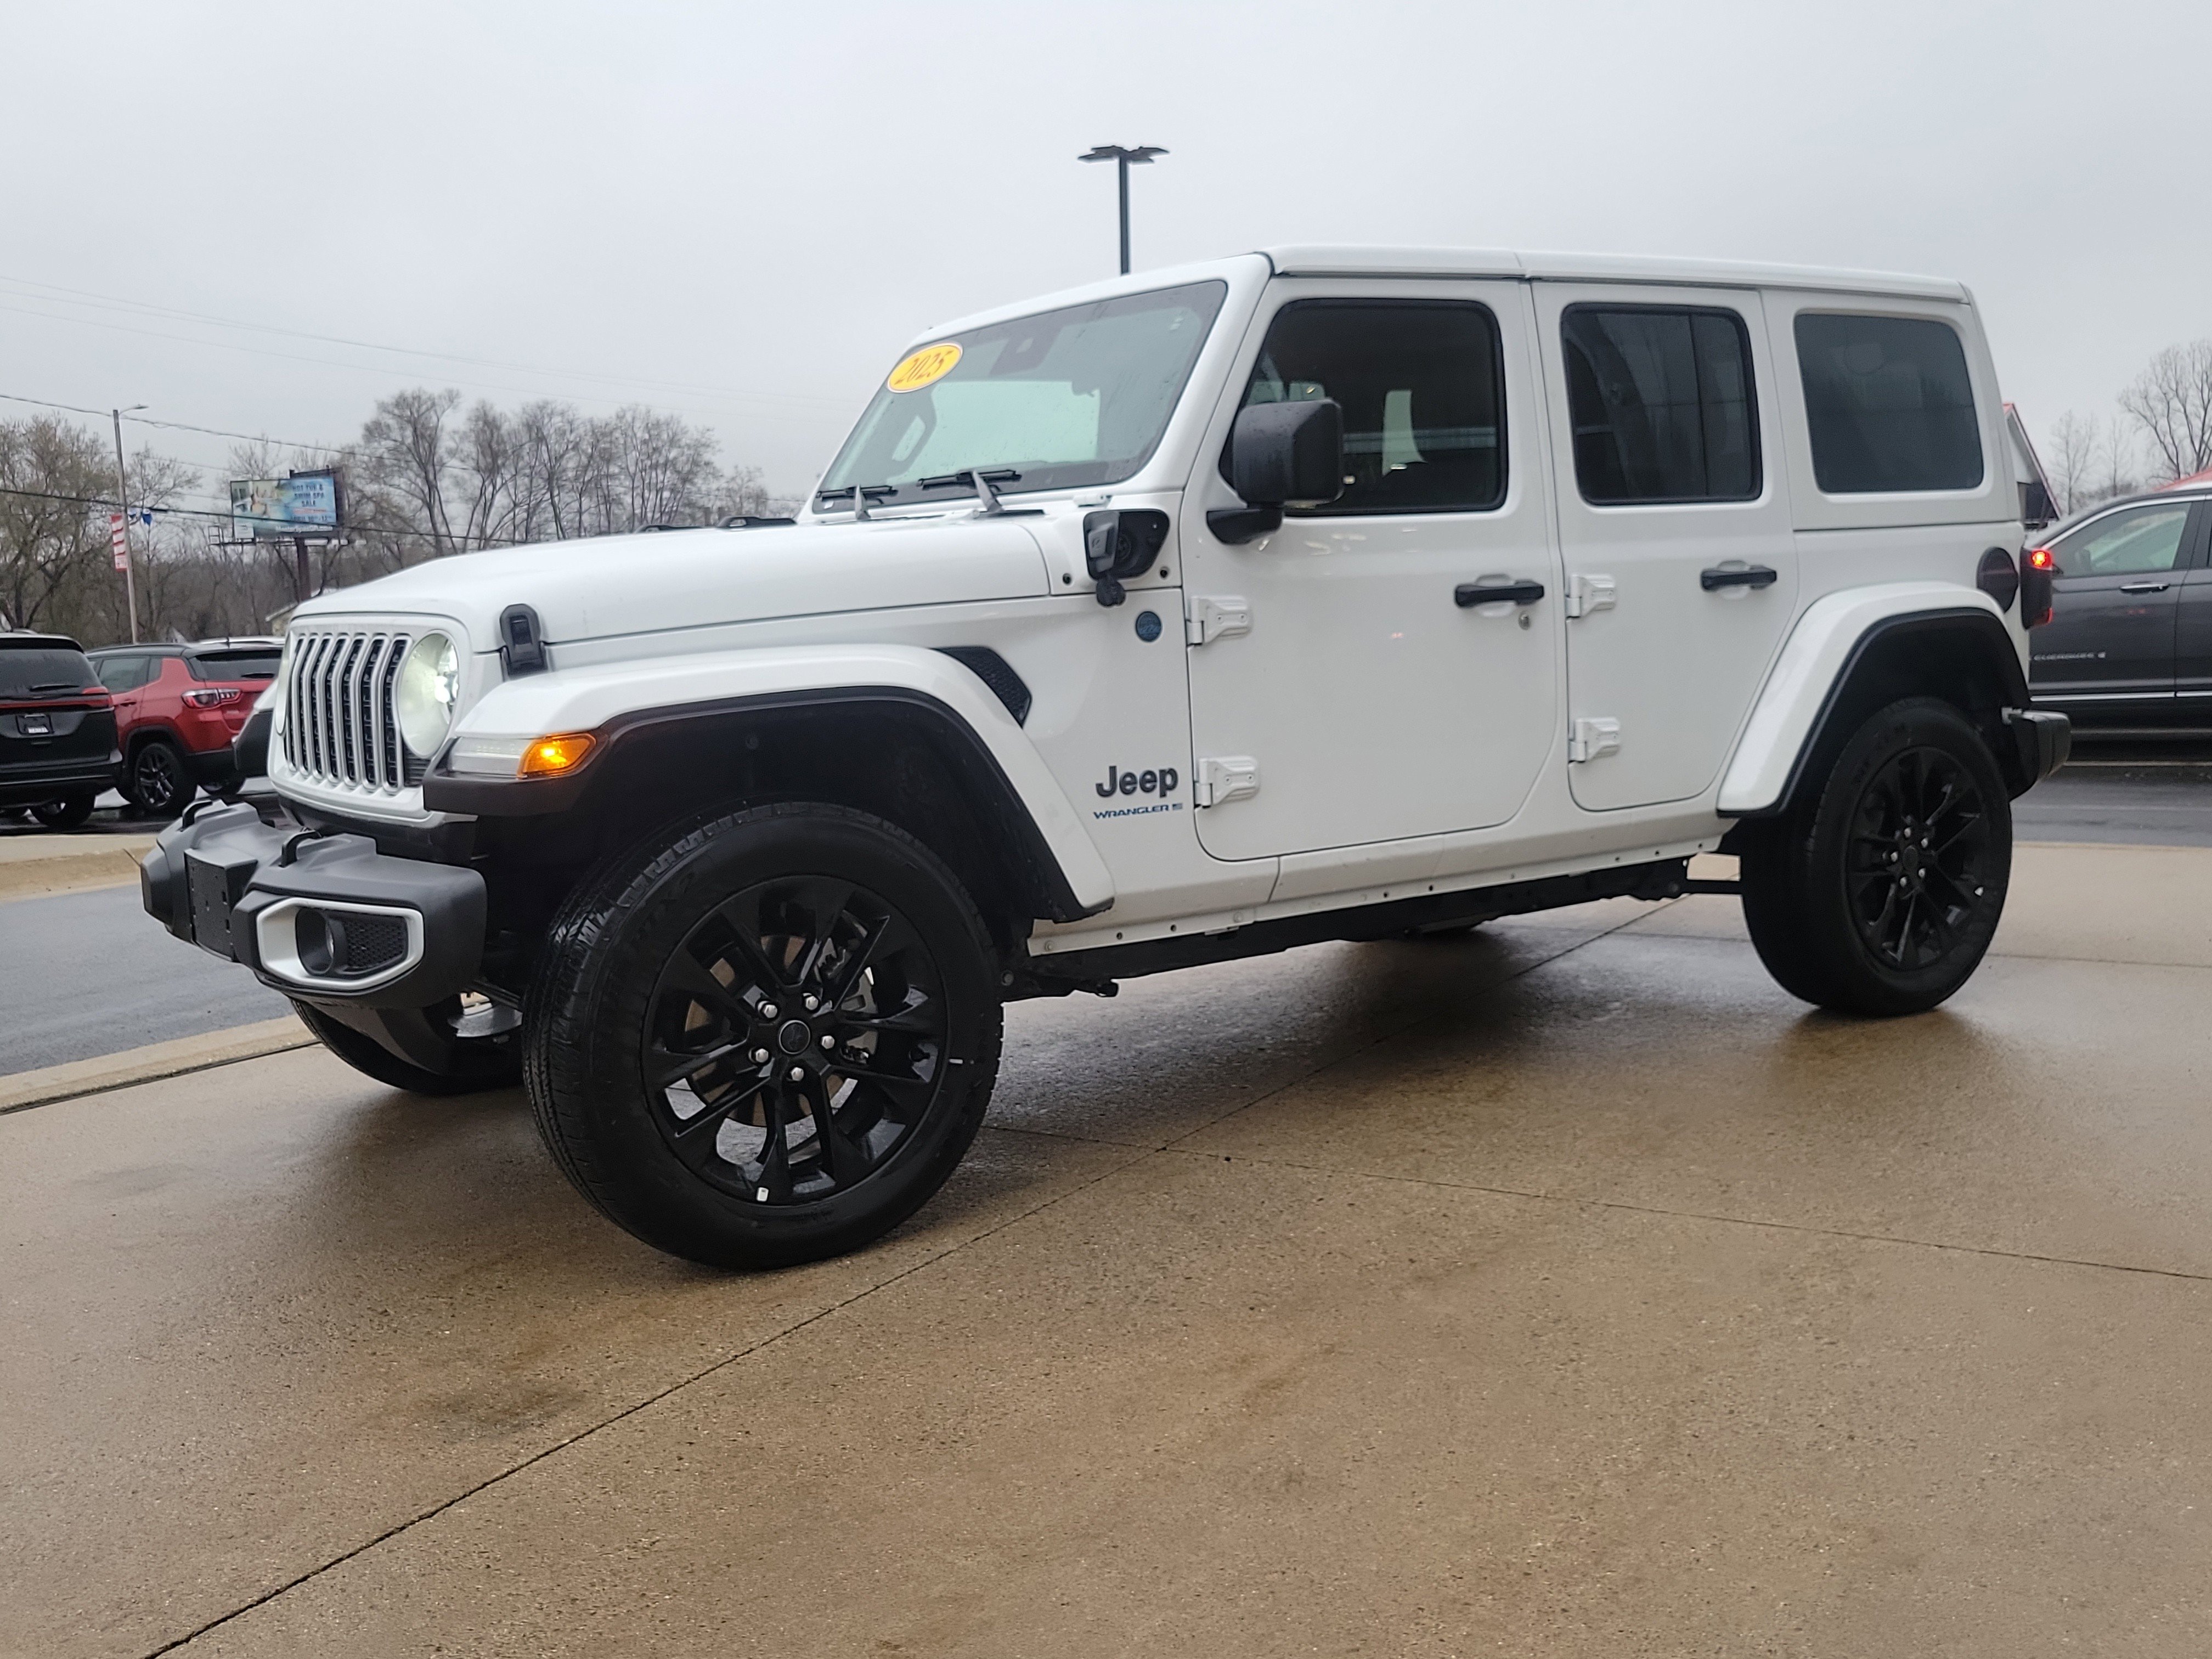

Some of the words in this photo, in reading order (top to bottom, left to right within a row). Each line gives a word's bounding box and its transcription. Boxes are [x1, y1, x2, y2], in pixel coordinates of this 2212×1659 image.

[894, 349, 955, 385] 2025
[1096, 765, 1178, 798] Jeep
[1093, 804, 1169, 819] WRANGLER
